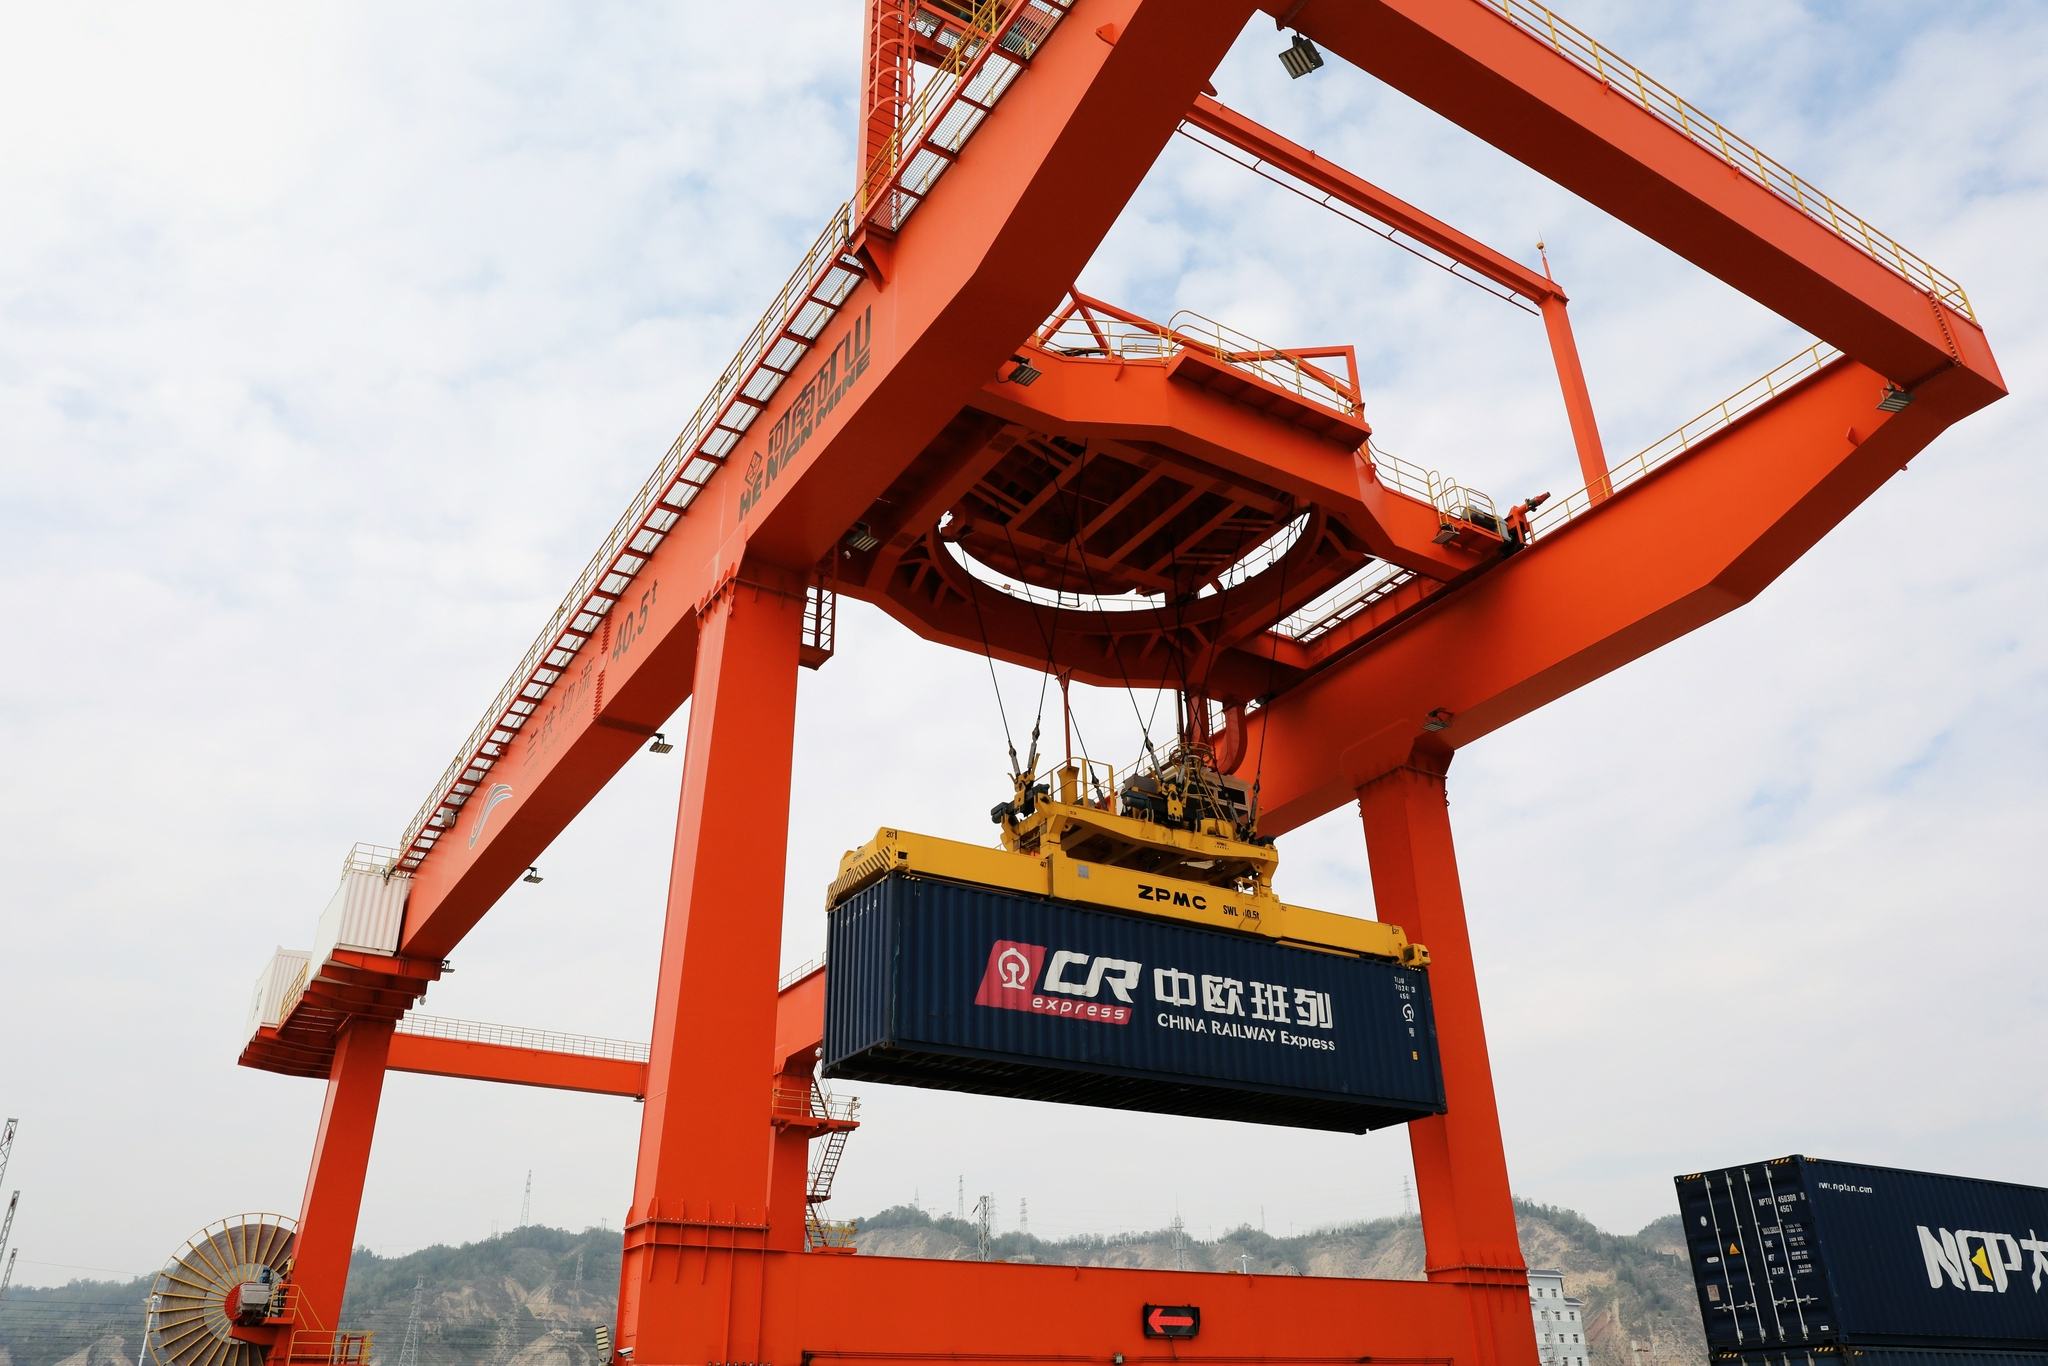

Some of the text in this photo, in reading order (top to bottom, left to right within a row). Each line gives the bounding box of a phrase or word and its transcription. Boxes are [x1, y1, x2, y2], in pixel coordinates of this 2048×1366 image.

[767, 303, 872, 457] 河南矿山
[739, 346, 871, 523] HENAN MINE
[1137, 884, 1207, 910] ZPMC
[1223, 905, 1239, 917] SWL
[1043, 950, 1143, 1004] CR
[1153, 967, 1335, 1030] 中欧班列
[1031, 996, 1126, 1020] express
[1157, 1013, 1336, 1051] CHINA RAILWAY Express
